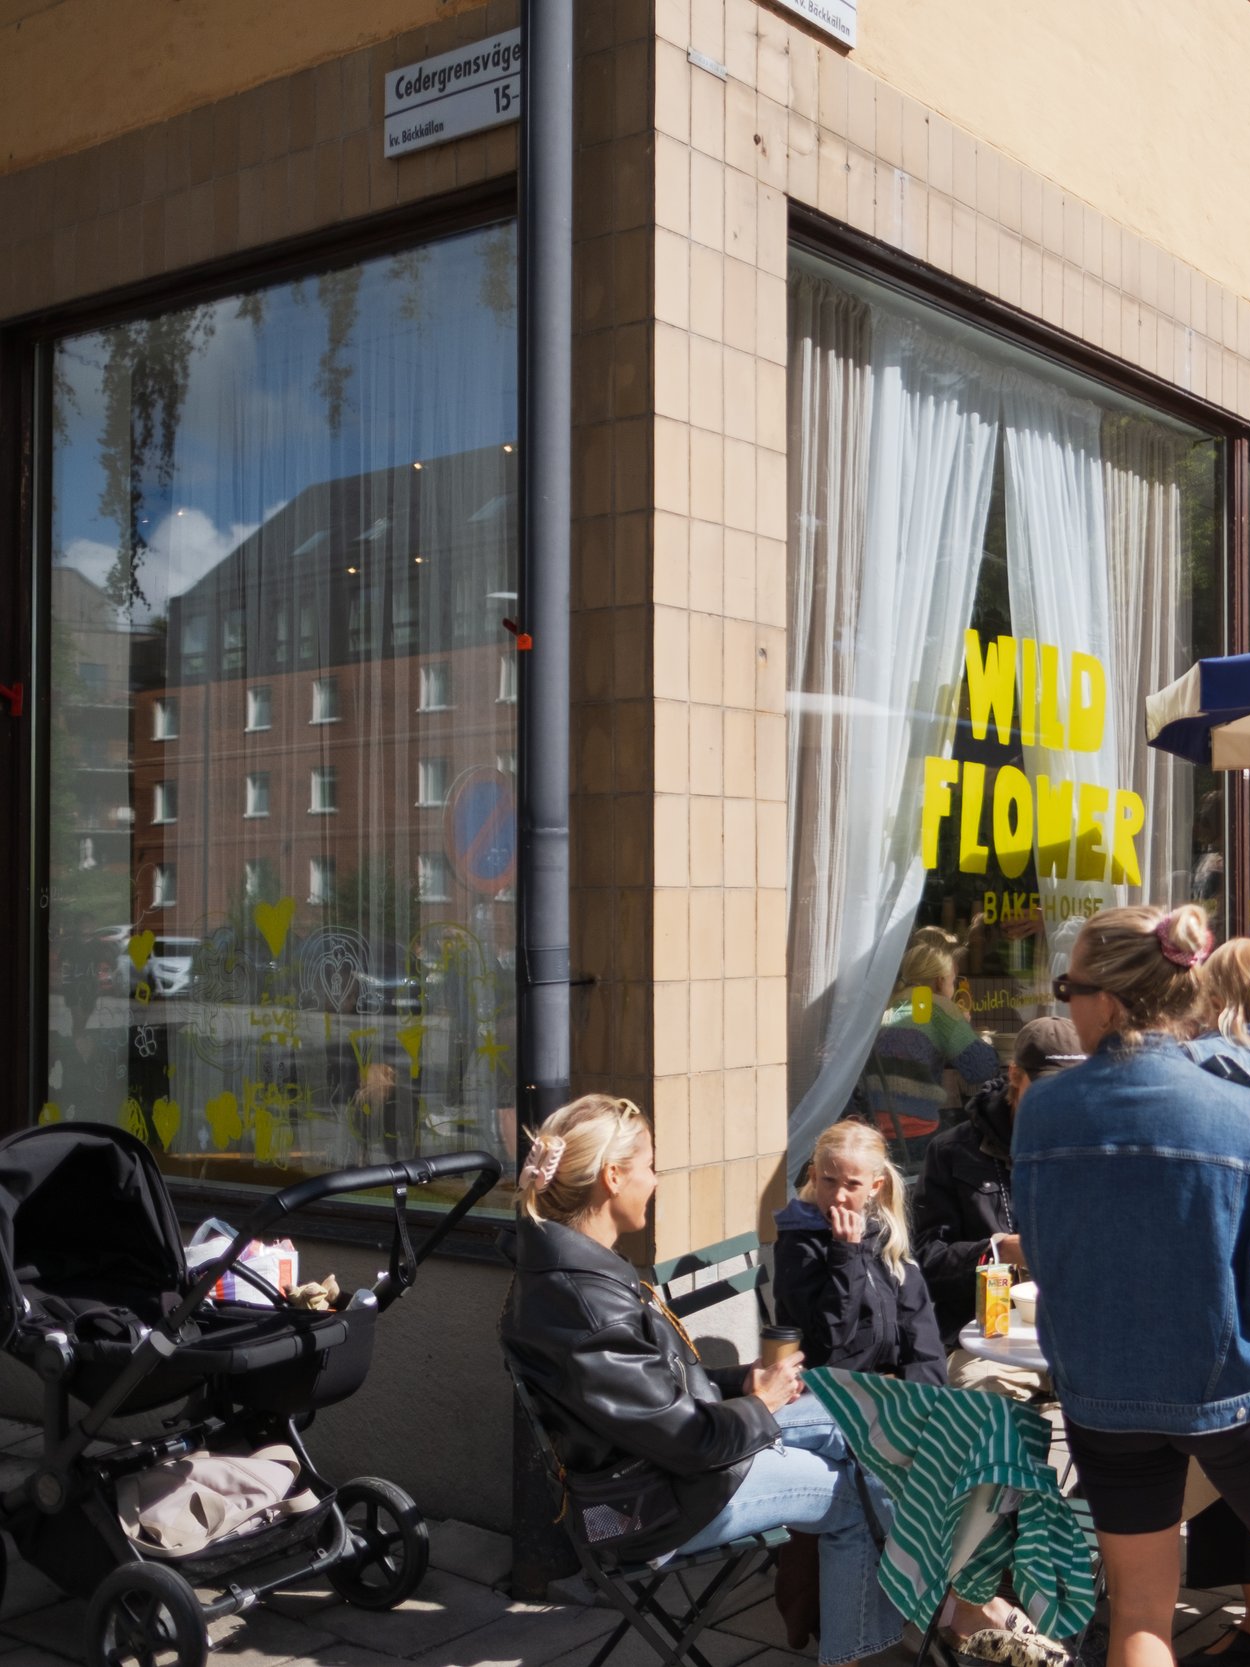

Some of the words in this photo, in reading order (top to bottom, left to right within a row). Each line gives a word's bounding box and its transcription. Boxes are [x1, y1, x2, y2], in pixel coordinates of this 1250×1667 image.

[808, 0, 850, 36] Bäckkällan
[395, 42, 521, 100] Cedergrensväge
[389, 134, 400, 147] kv.
[402, 120, 444, 144] Bäckkällan
[964, 628, 1107, 753] WILD
[922, 756, 1146, 887] FLOWER
